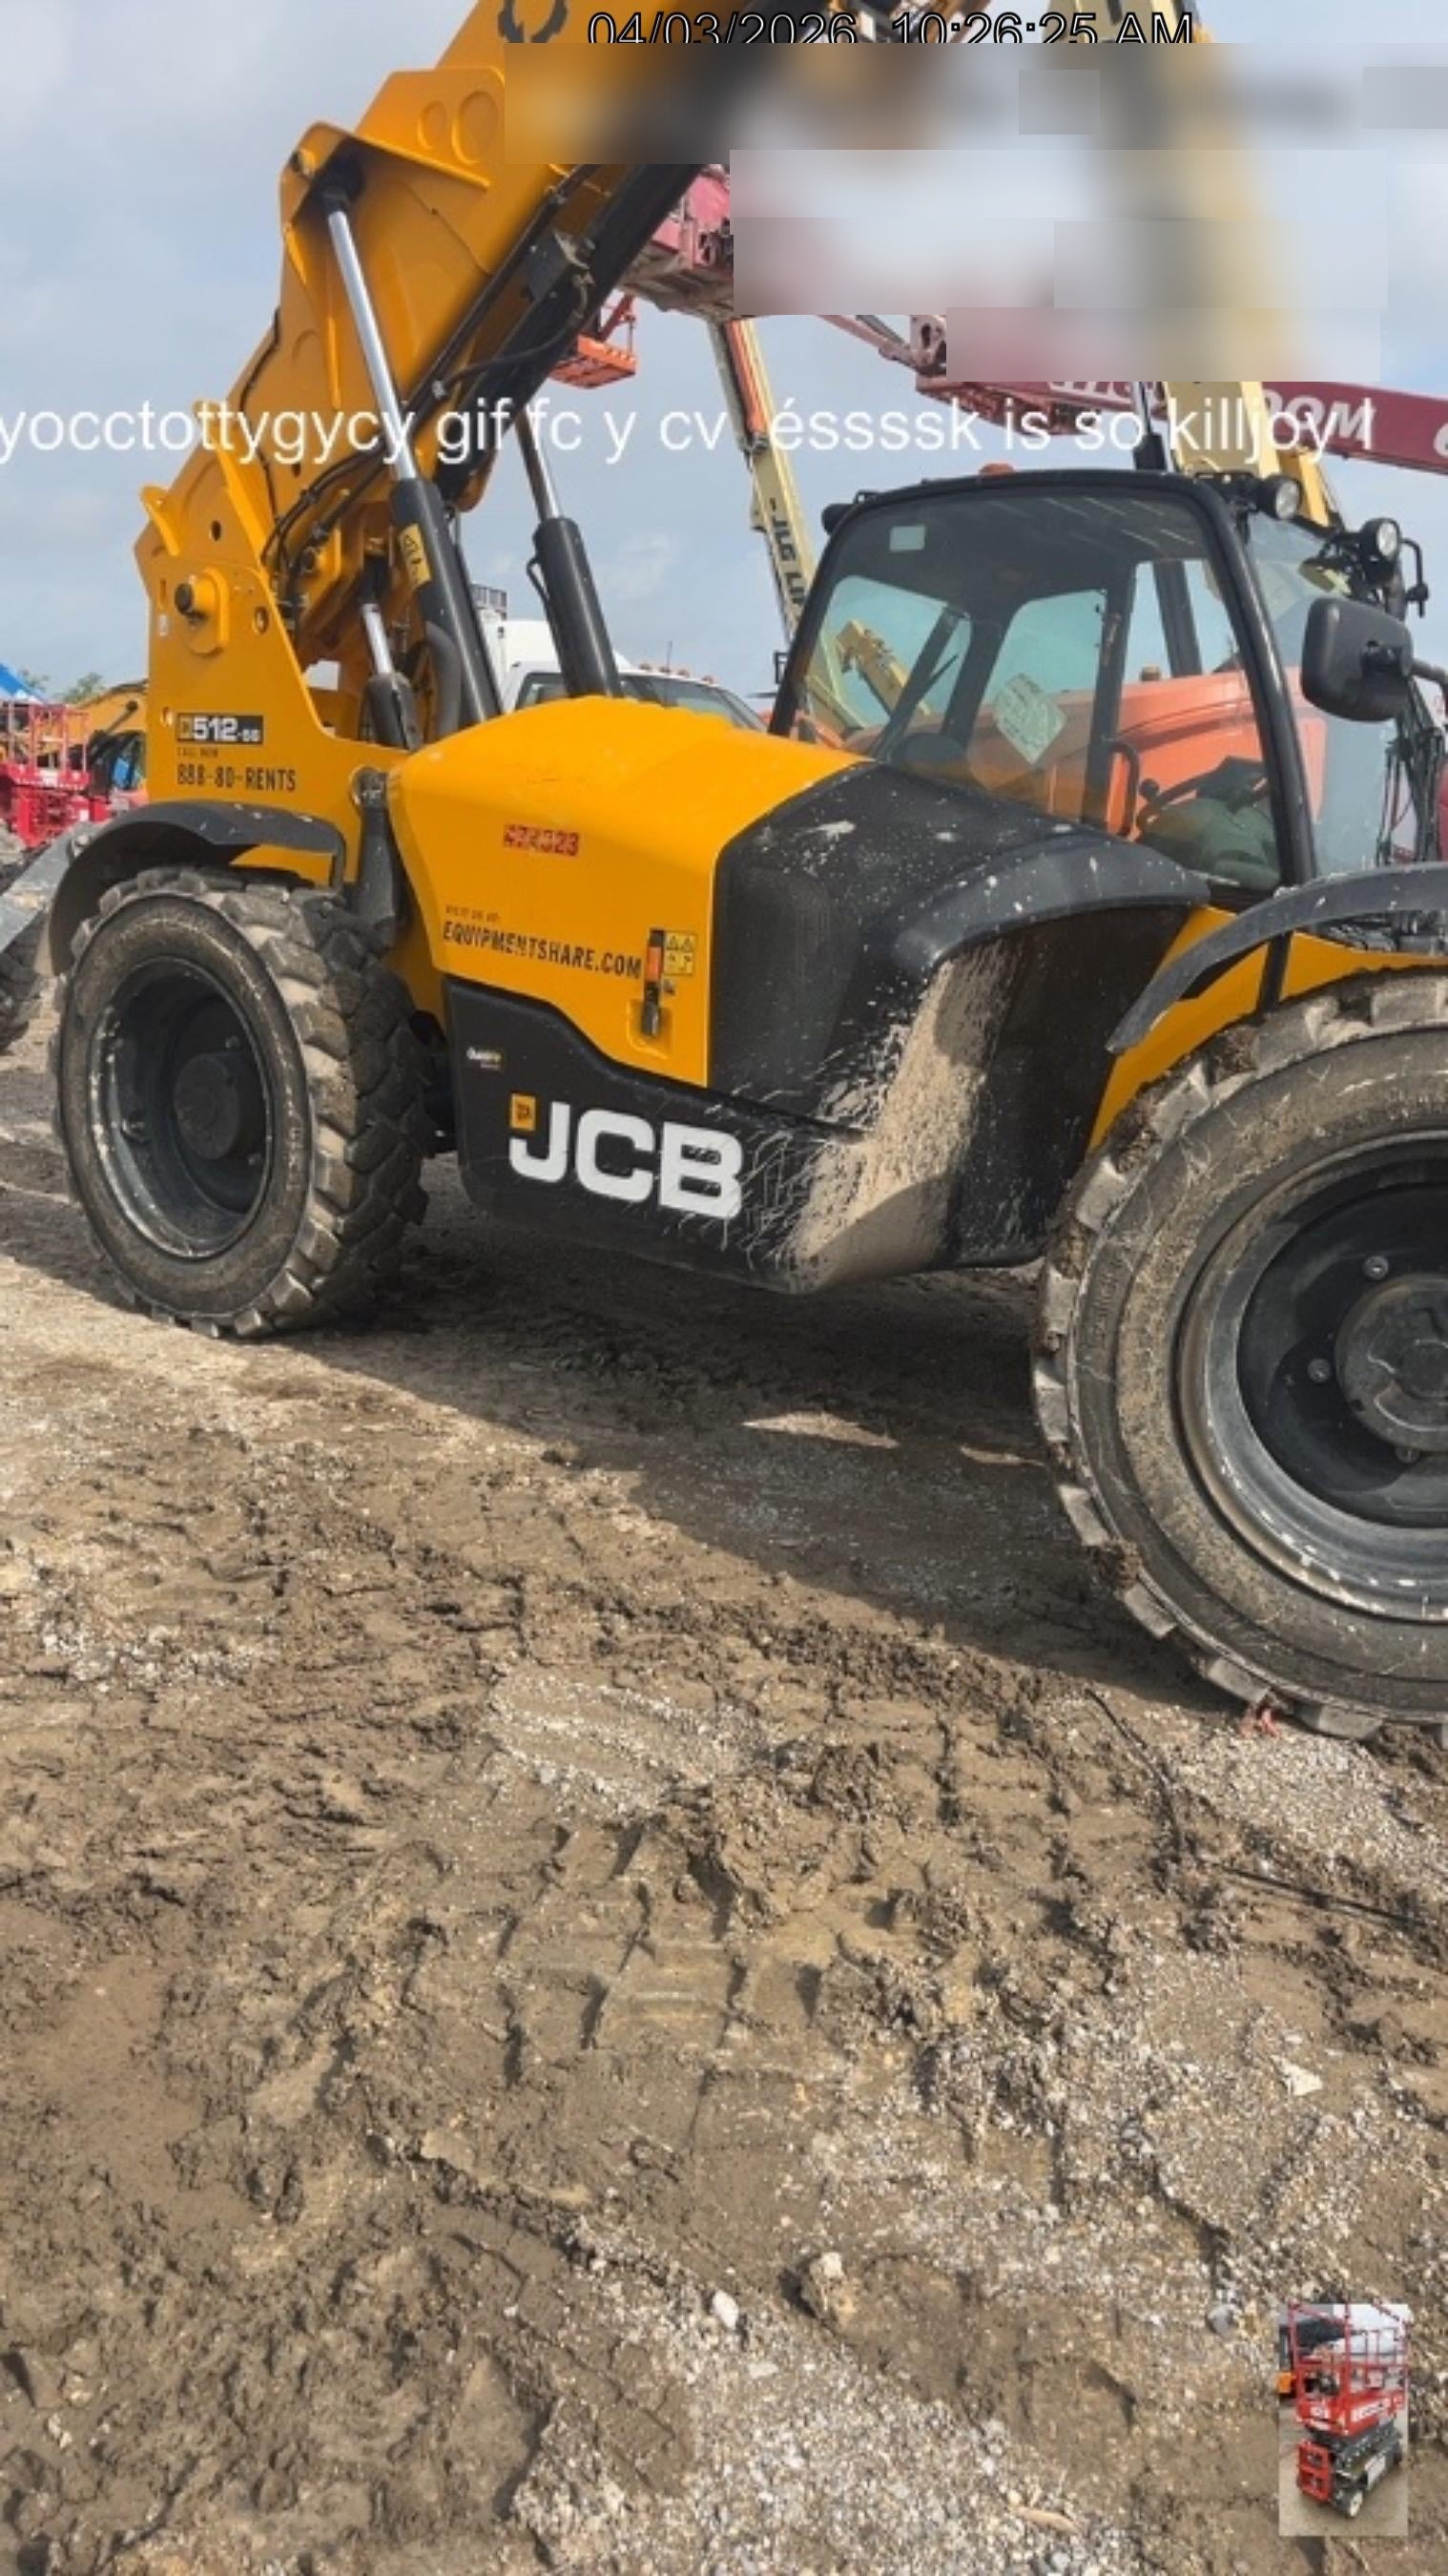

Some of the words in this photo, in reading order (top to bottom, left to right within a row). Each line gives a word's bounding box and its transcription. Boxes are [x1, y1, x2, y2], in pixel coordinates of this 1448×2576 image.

[177, 762, 297, 792] 888-80-RENTS
[443, 920, 642, 980] EQUIPMENTSHARE.COM
[508, 1100, 743, 1220] JCB
